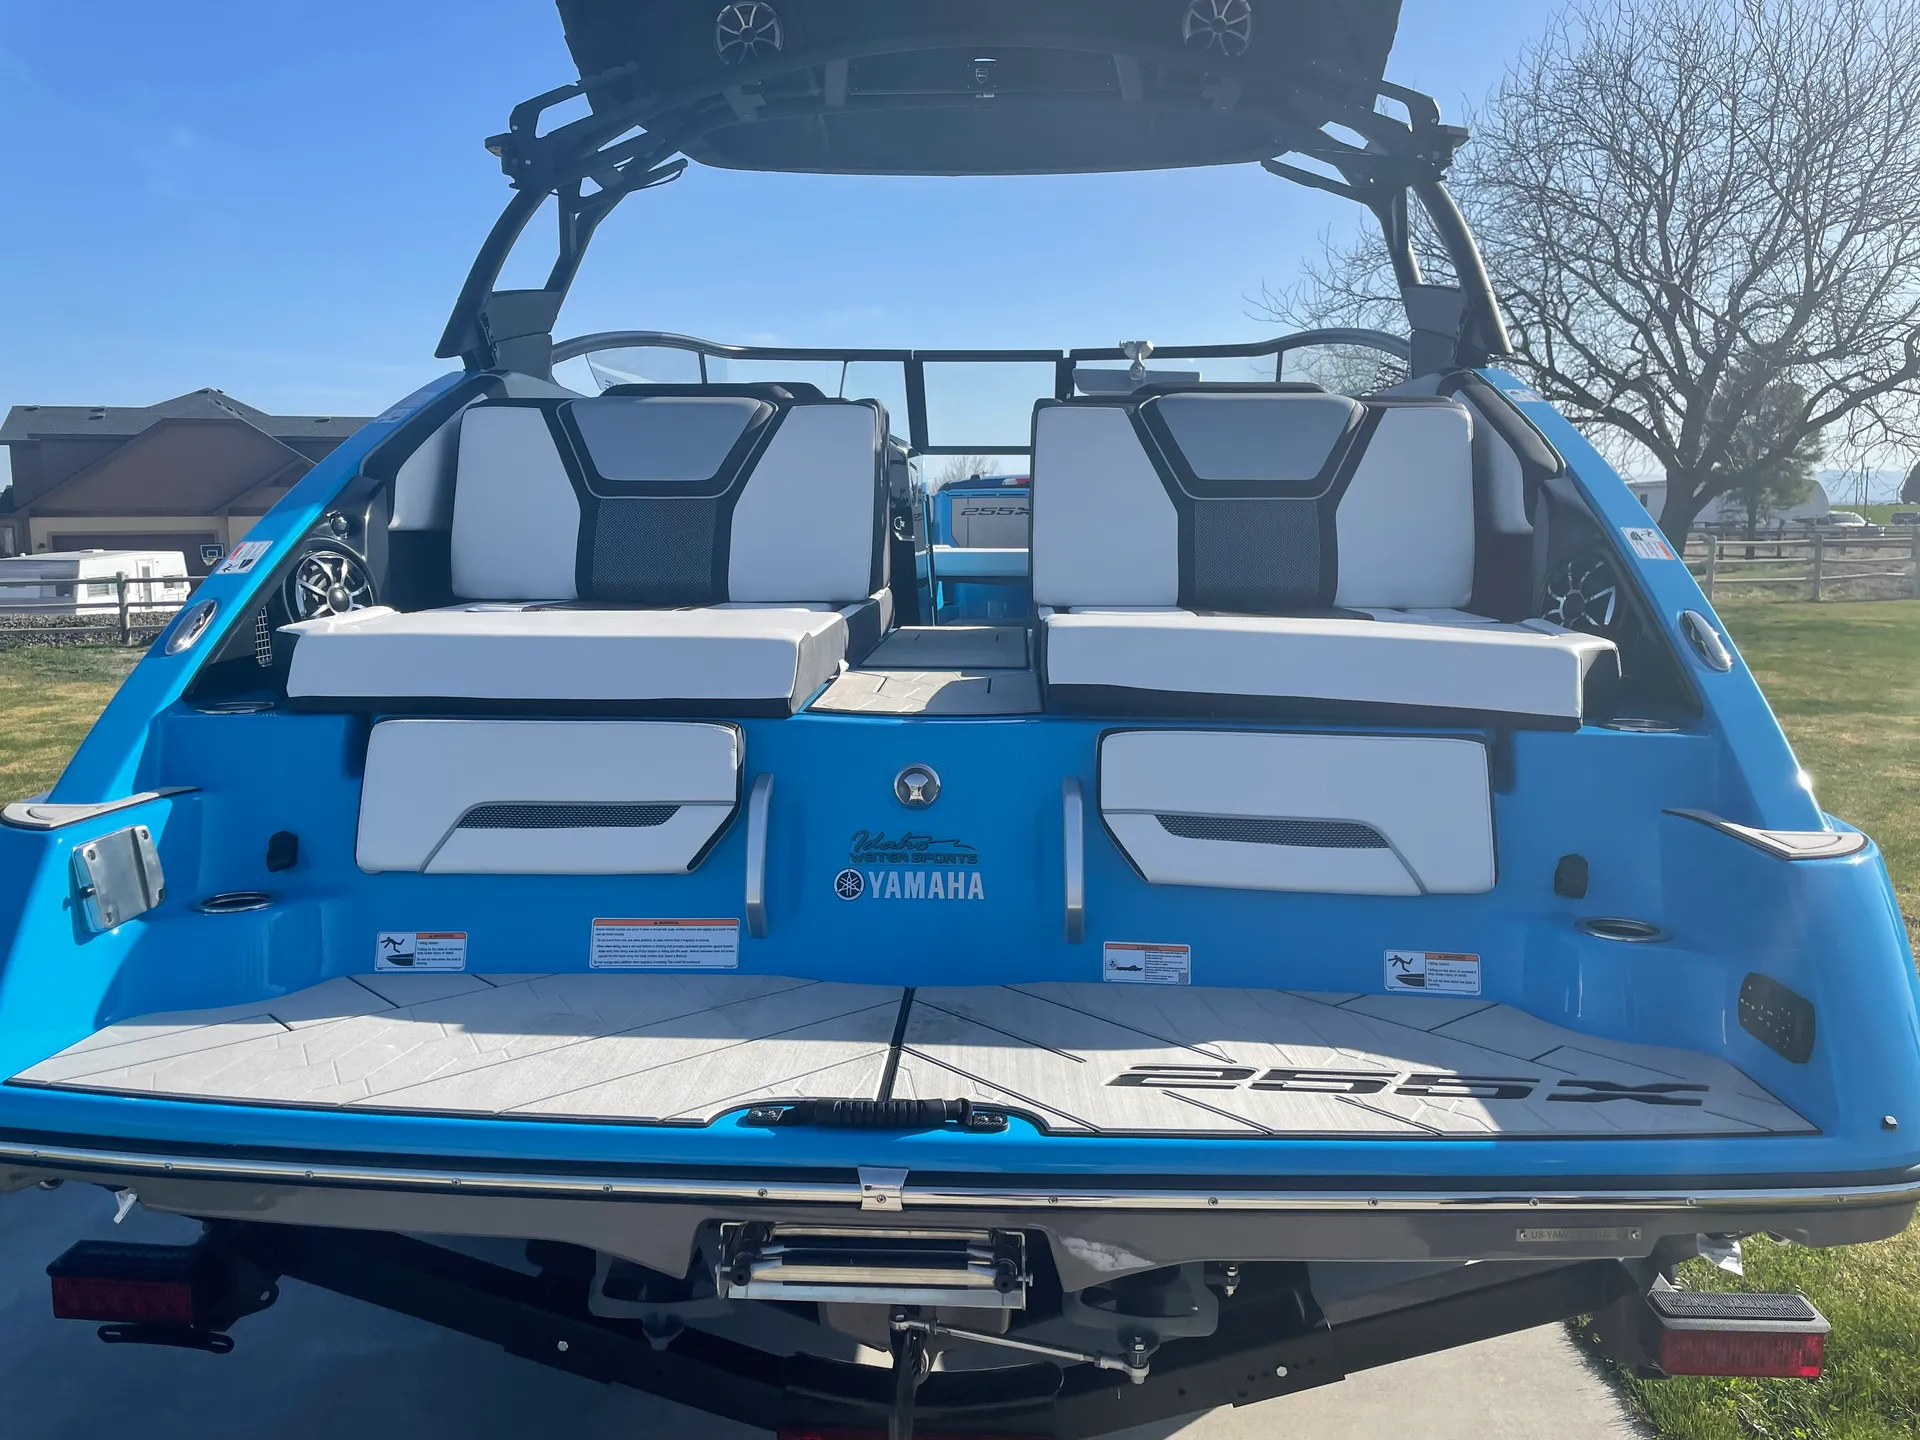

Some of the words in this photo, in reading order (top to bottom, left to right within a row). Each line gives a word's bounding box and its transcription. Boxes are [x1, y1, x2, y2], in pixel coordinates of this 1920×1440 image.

[852, 830, 960, 853] Idaho
[911, 852, 978, 865] SPORTS
[868, 870, 985, 900] YAMAHA
